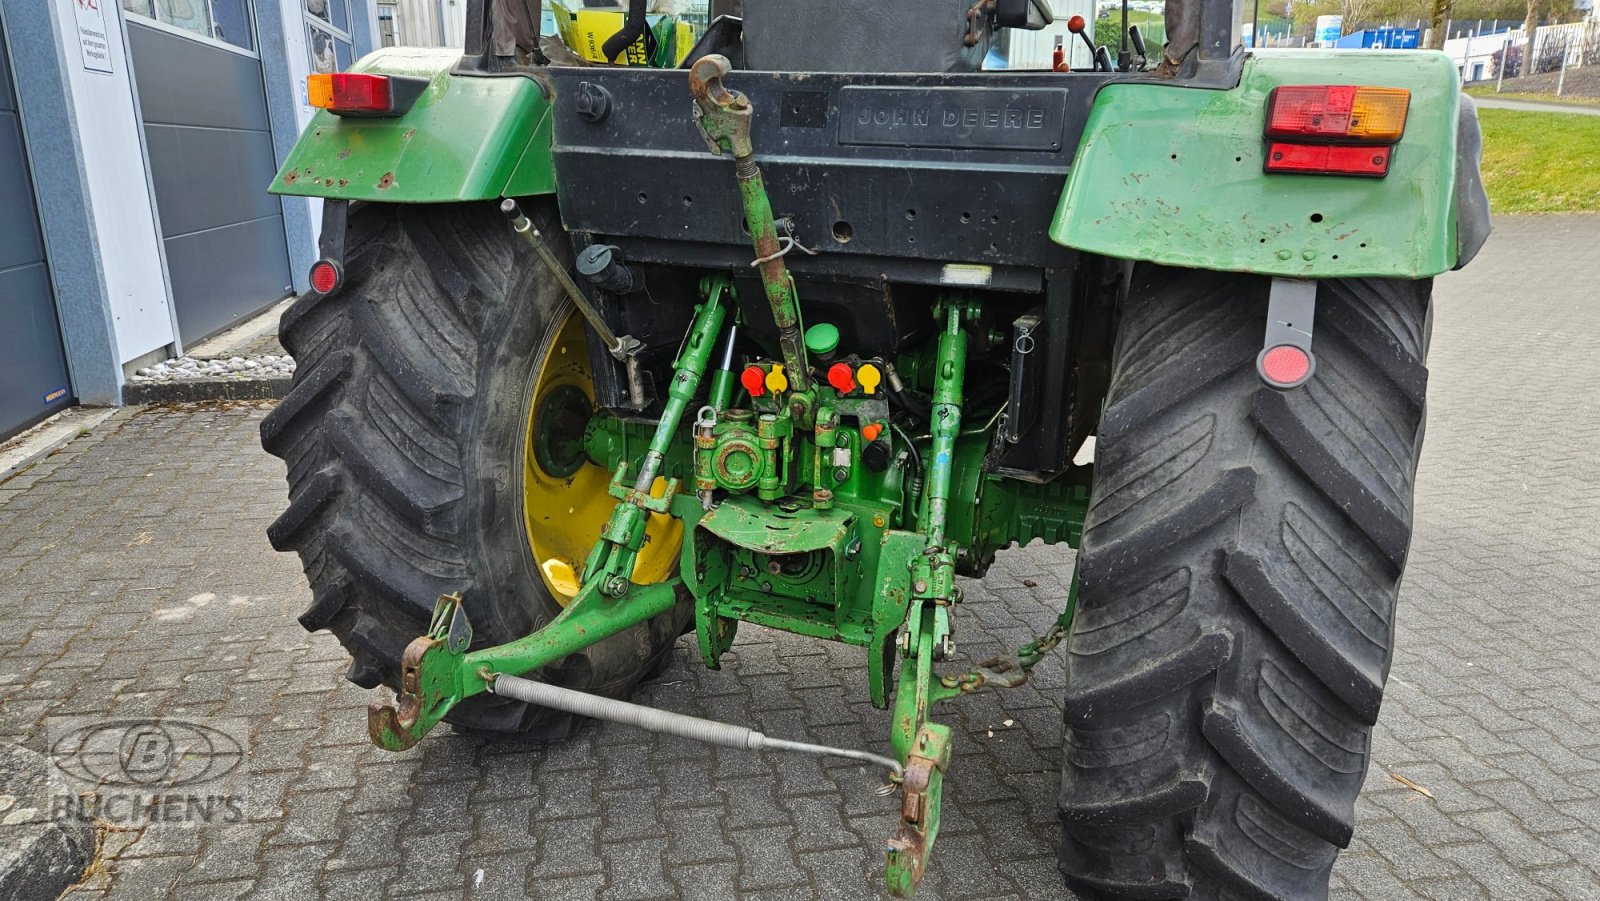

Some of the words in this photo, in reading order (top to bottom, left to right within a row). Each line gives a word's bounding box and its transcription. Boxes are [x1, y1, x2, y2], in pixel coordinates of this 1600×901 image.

[636, 33, 647, 65] ANN
[857, 106, 930, 127] JOHN
[942, 108, 1044, 129] DEERE
